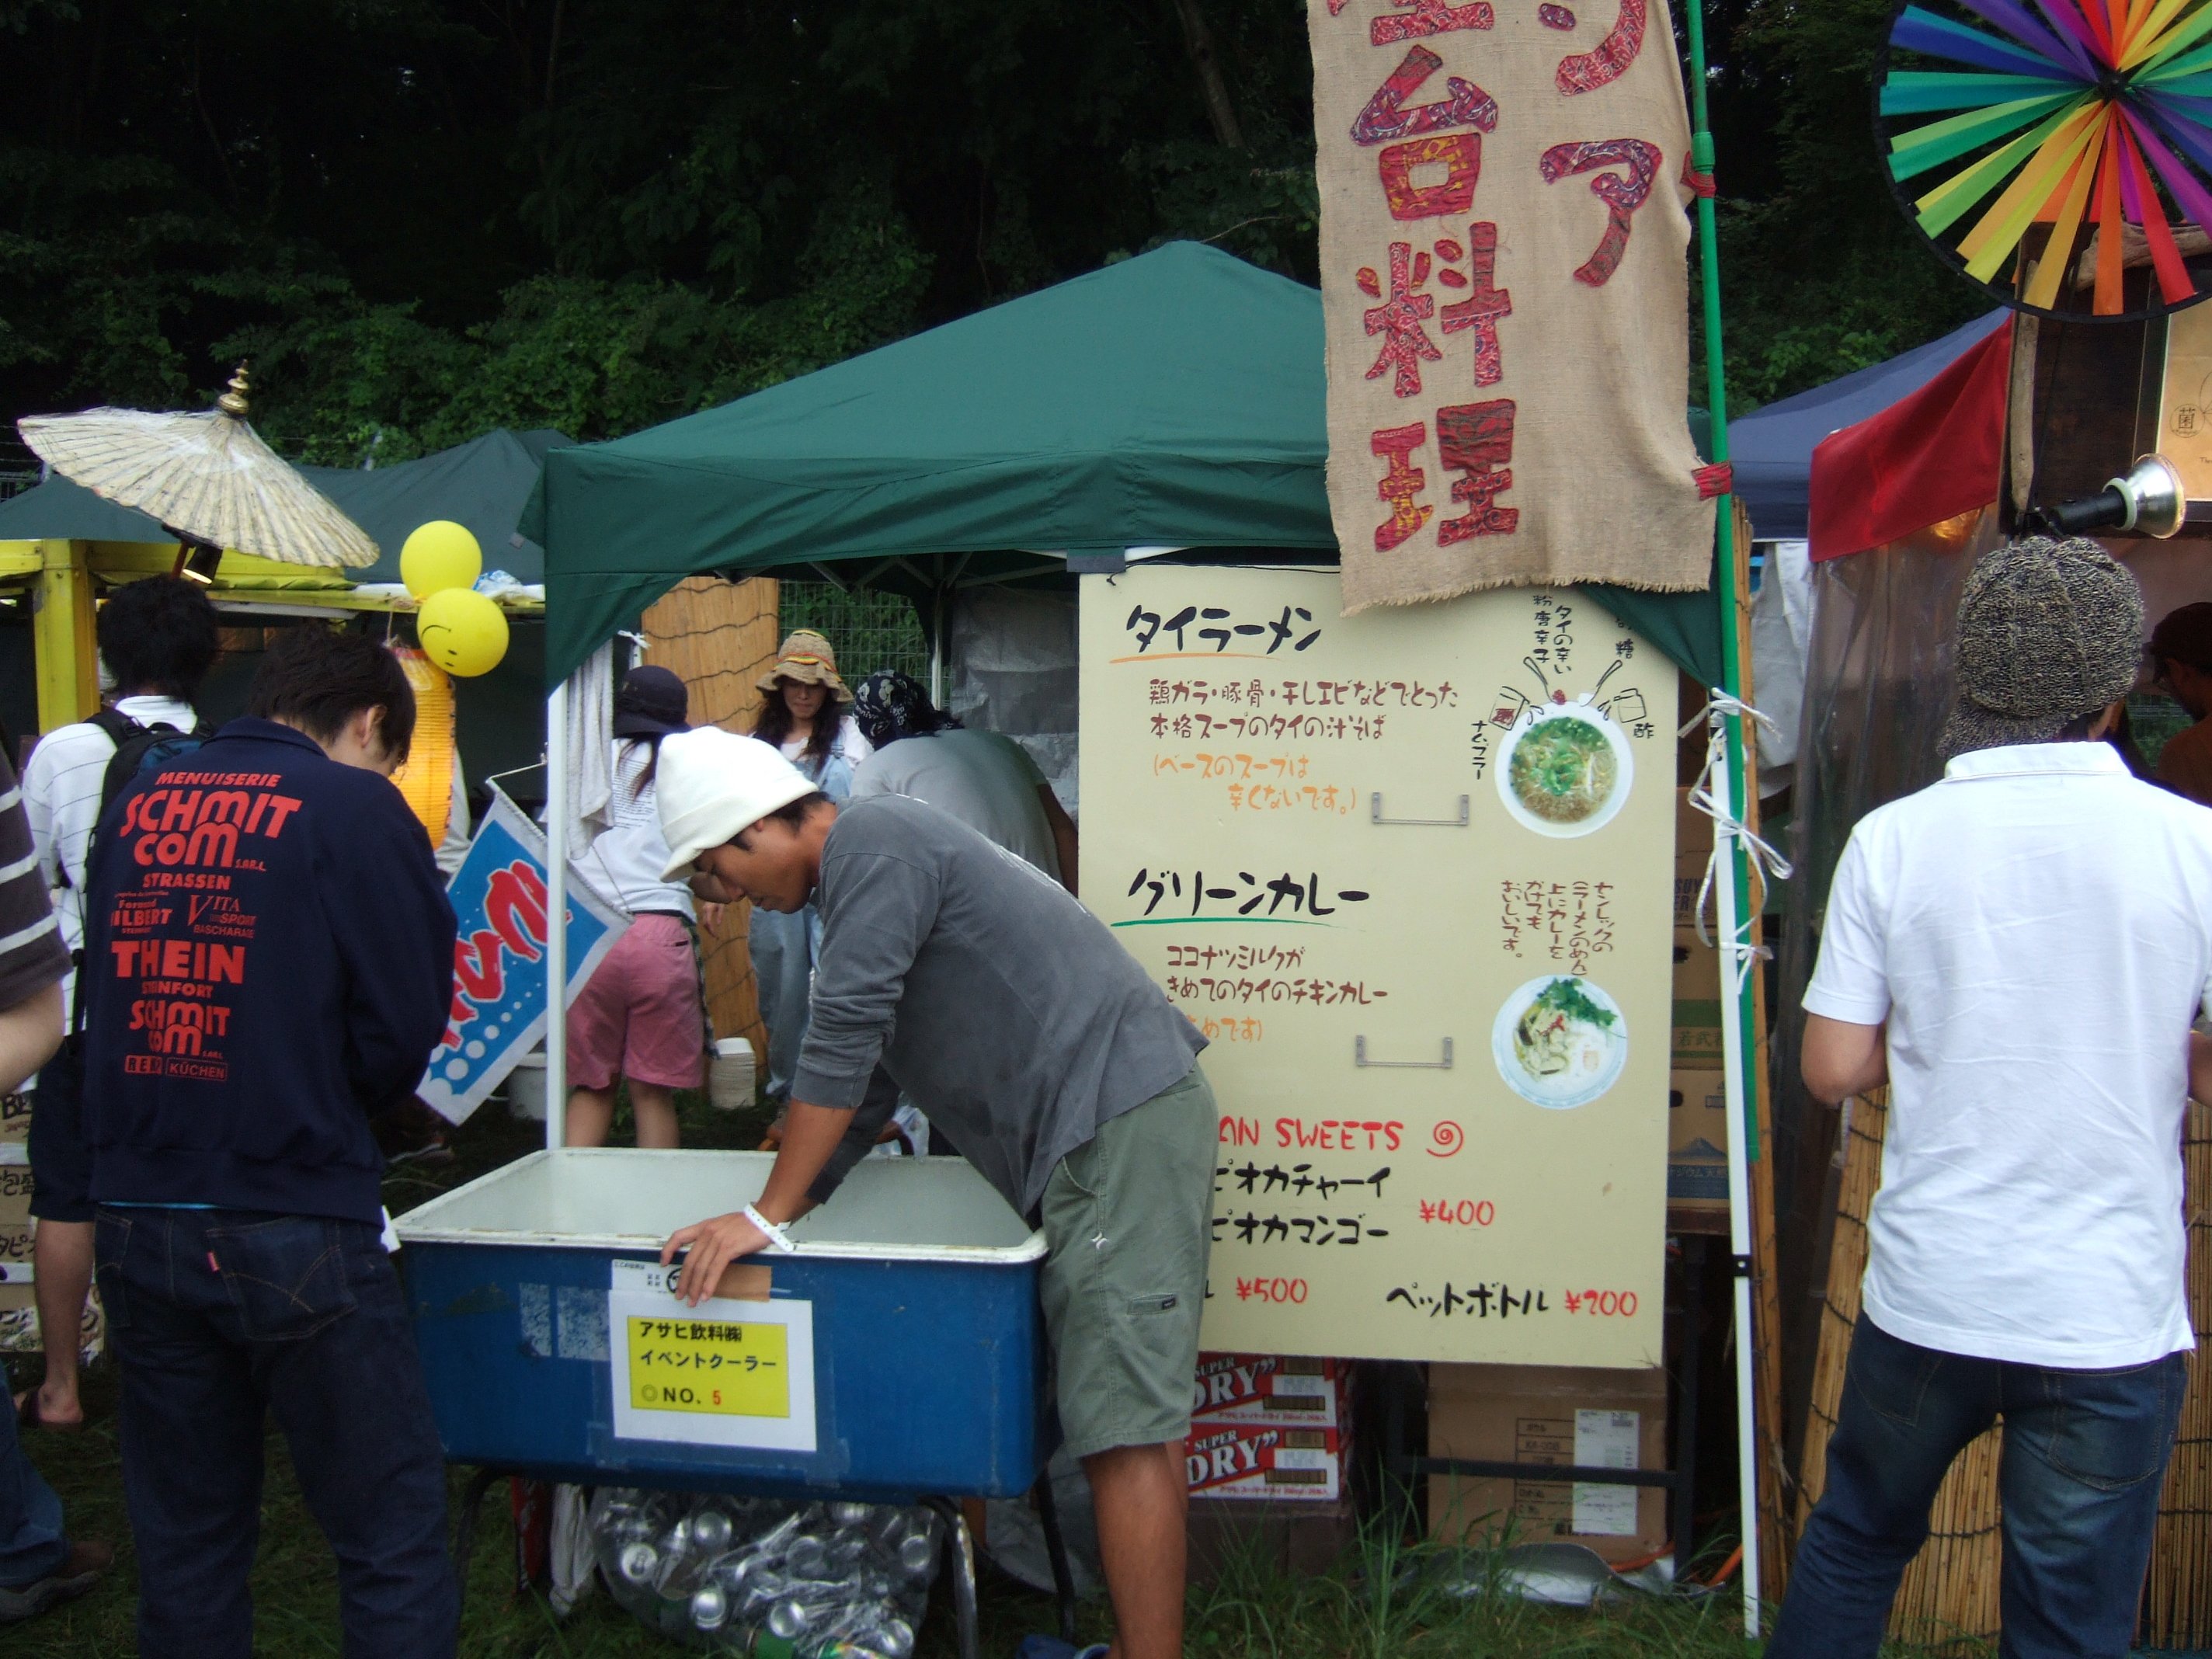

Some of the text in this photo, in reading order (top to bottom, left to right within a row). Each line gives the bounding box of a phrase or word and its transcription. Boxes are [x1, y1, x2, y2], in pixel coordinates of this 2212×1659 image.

[1126, 604, 1322, 654] タイラーメン
[1532, 594, 1553, 663] 粉唐辛子
[1554, 605, 1573, 674] タイの辛い
[1149, 711, 1387, 740] 本格スープのタイの汁そば
[1633, 723, 1655, 739] 酢
[155, 771, 282, 788] MENUISERIE
[1153, 751, 1309, 779] (ベースのスープは
[119, 788, 304, 839] SCHMIT
[134, 822, 240, 868] COM
[143, 872, 232, 891] STRASSEN
[1128, 868, 1370, 916] グリーンカレー
[187, 894, 241, 927] VITA
[1501, 879, 1523, 958] おいしいです。
[1524, 880, 1546, 930] かけても
[1548, 883, 1567, 959] 上にカレーを
[1592, 882, 1616, 952] センレックの
[111, 939, 245, 984] THEIN
[1167, 976, 1389, 1006] きめてのタイのチキンカレー
[129, 1000, 231, 1037] SCHMIT
[1186, 1014, 1262, 1042] めです)
[1219, 1115, 1404, 1152] AN SWEETS
[1419, 1199, 1495, 1227] ¥400
[1236, 1276, 1308, 1304] ¥500
[1386, 1282, 1549, 1319] ペットボトル
[640, 1349, 777, 1372] イベントクーラー
[713, 1389, 722, 1406] 5
[1195, 1430, 1237, 1452] SUPER
